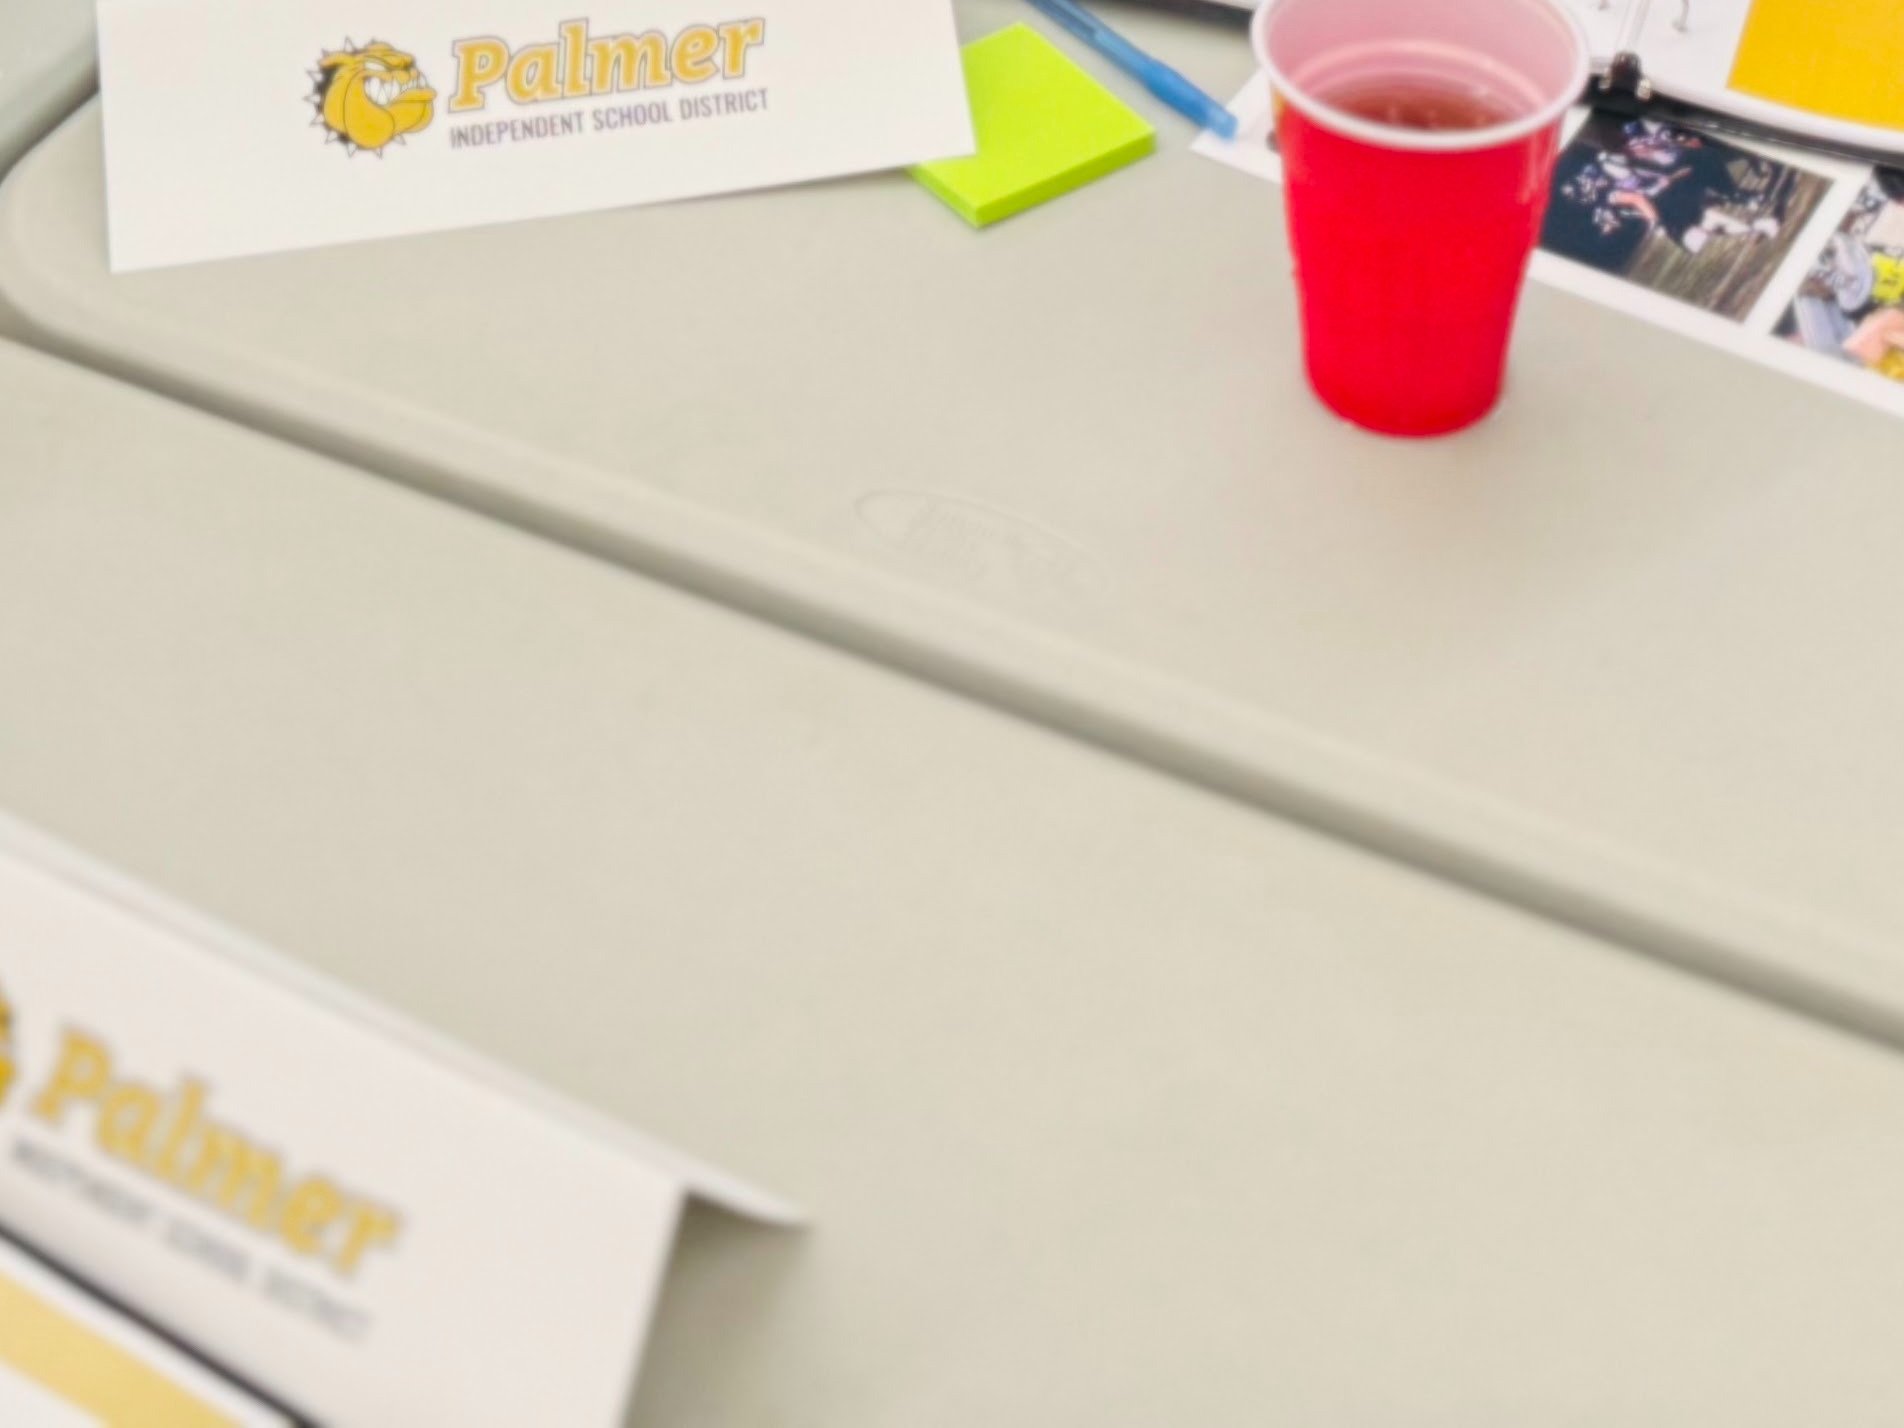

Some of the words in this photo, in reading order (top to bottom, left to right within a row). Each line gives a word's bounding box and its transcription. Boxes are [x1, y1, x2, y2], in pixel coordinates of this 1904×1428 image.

[448, 17, 766, 114] Palmer
[450, 111, 585, 150] INDEPENDENT
[593, 101, 672, 131] SCHOOL
[680, 88, 769, 121] DISTRICT
[28, 1020, 408, 1279] Palmer
